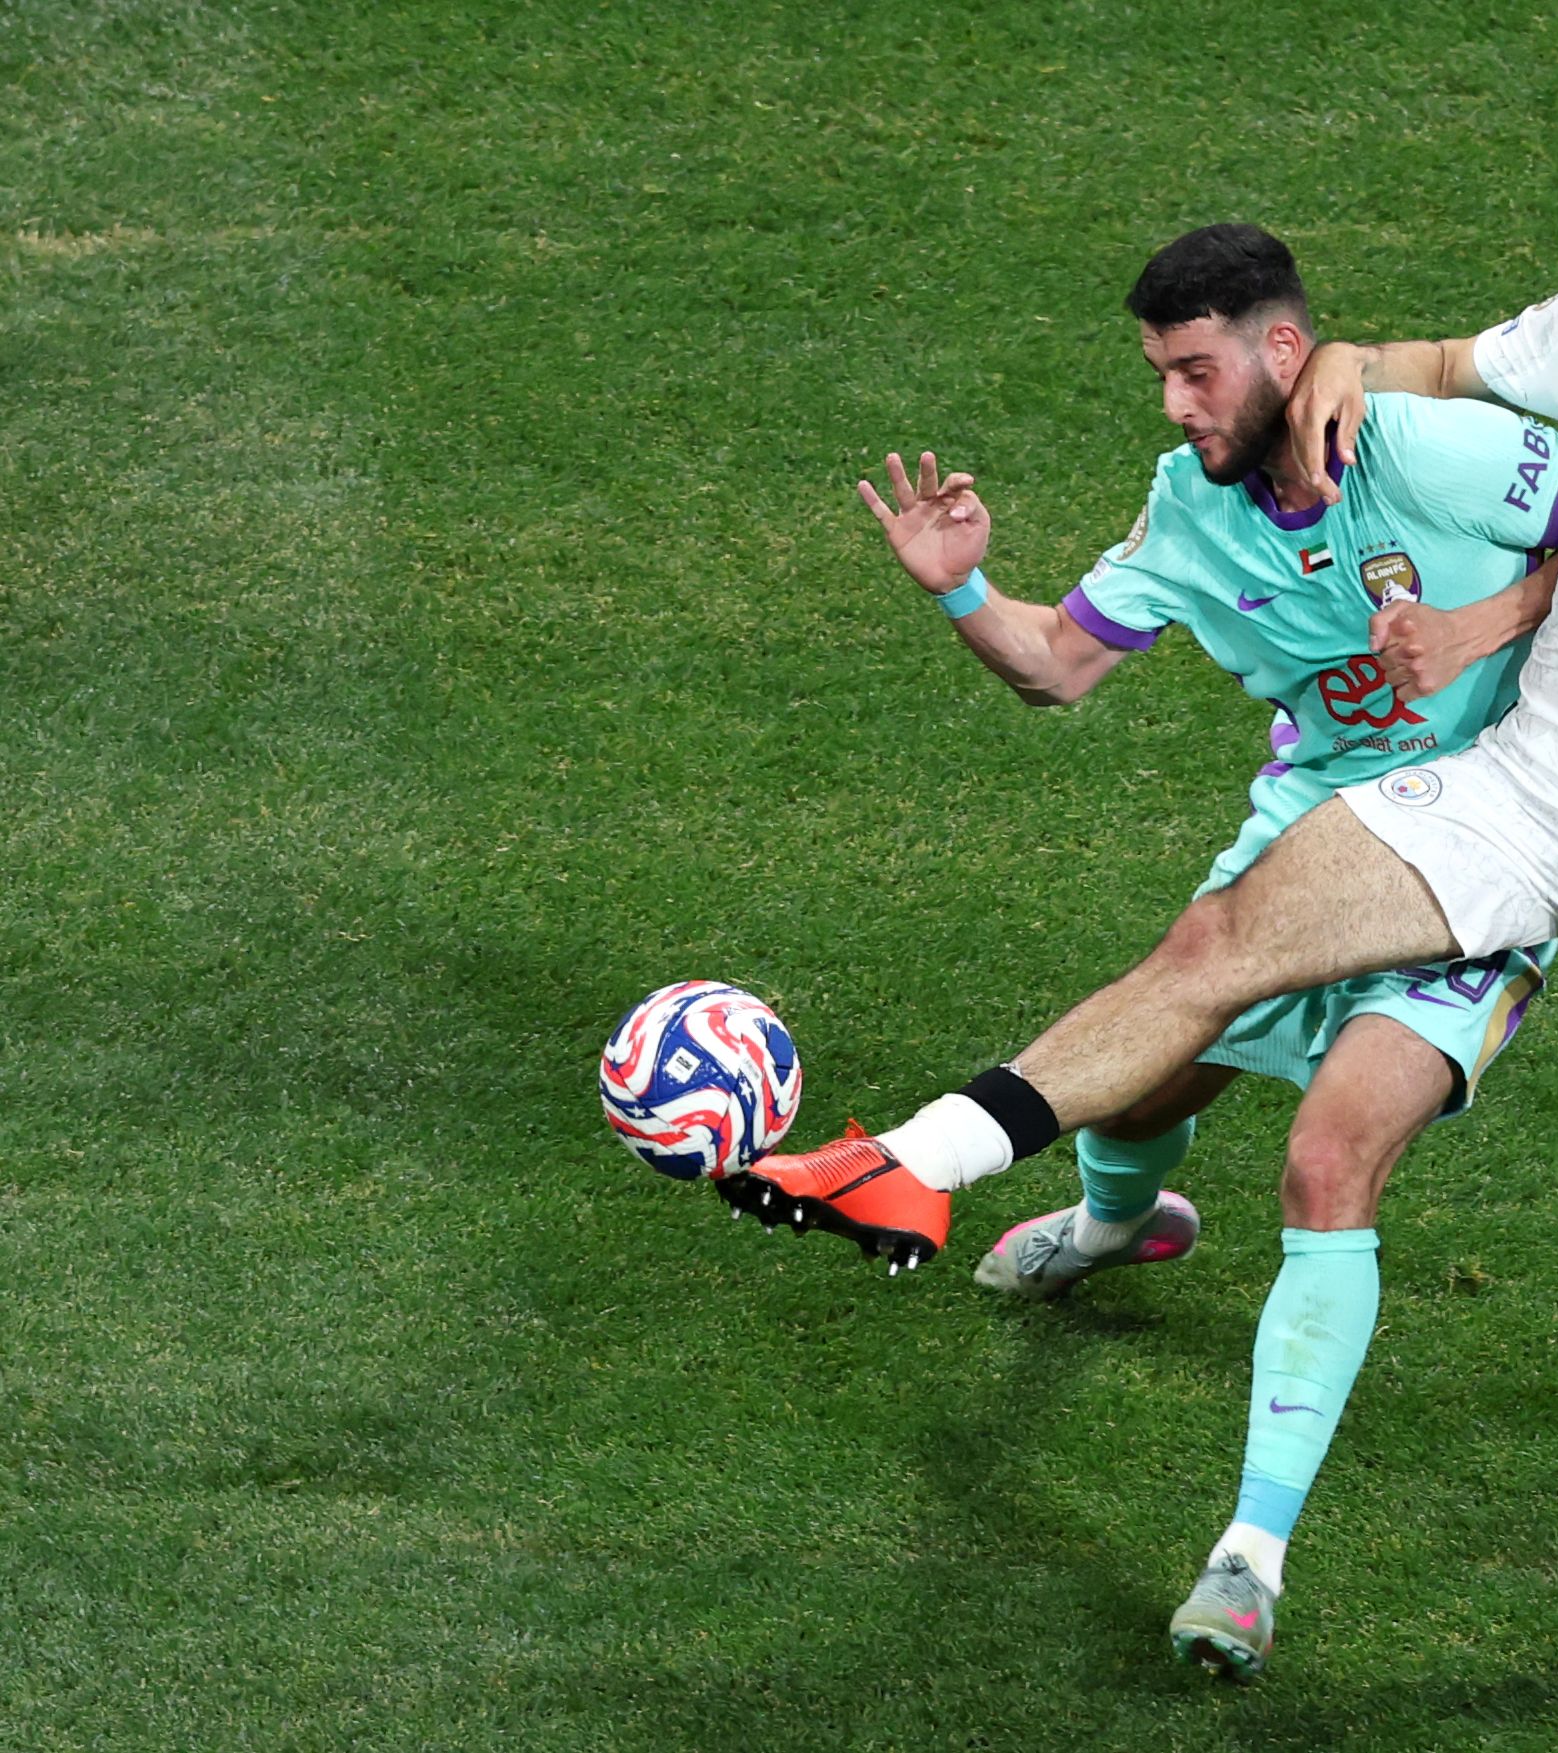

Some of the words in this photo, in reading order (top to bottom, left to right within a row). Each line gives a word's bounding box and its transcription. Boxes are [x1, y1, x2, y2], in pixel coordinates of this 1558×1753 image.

[1503, 428, 1550, 513] FAB
[1392, 562, 1407, 574] FC
[1397, 732, 1438, 752] and
